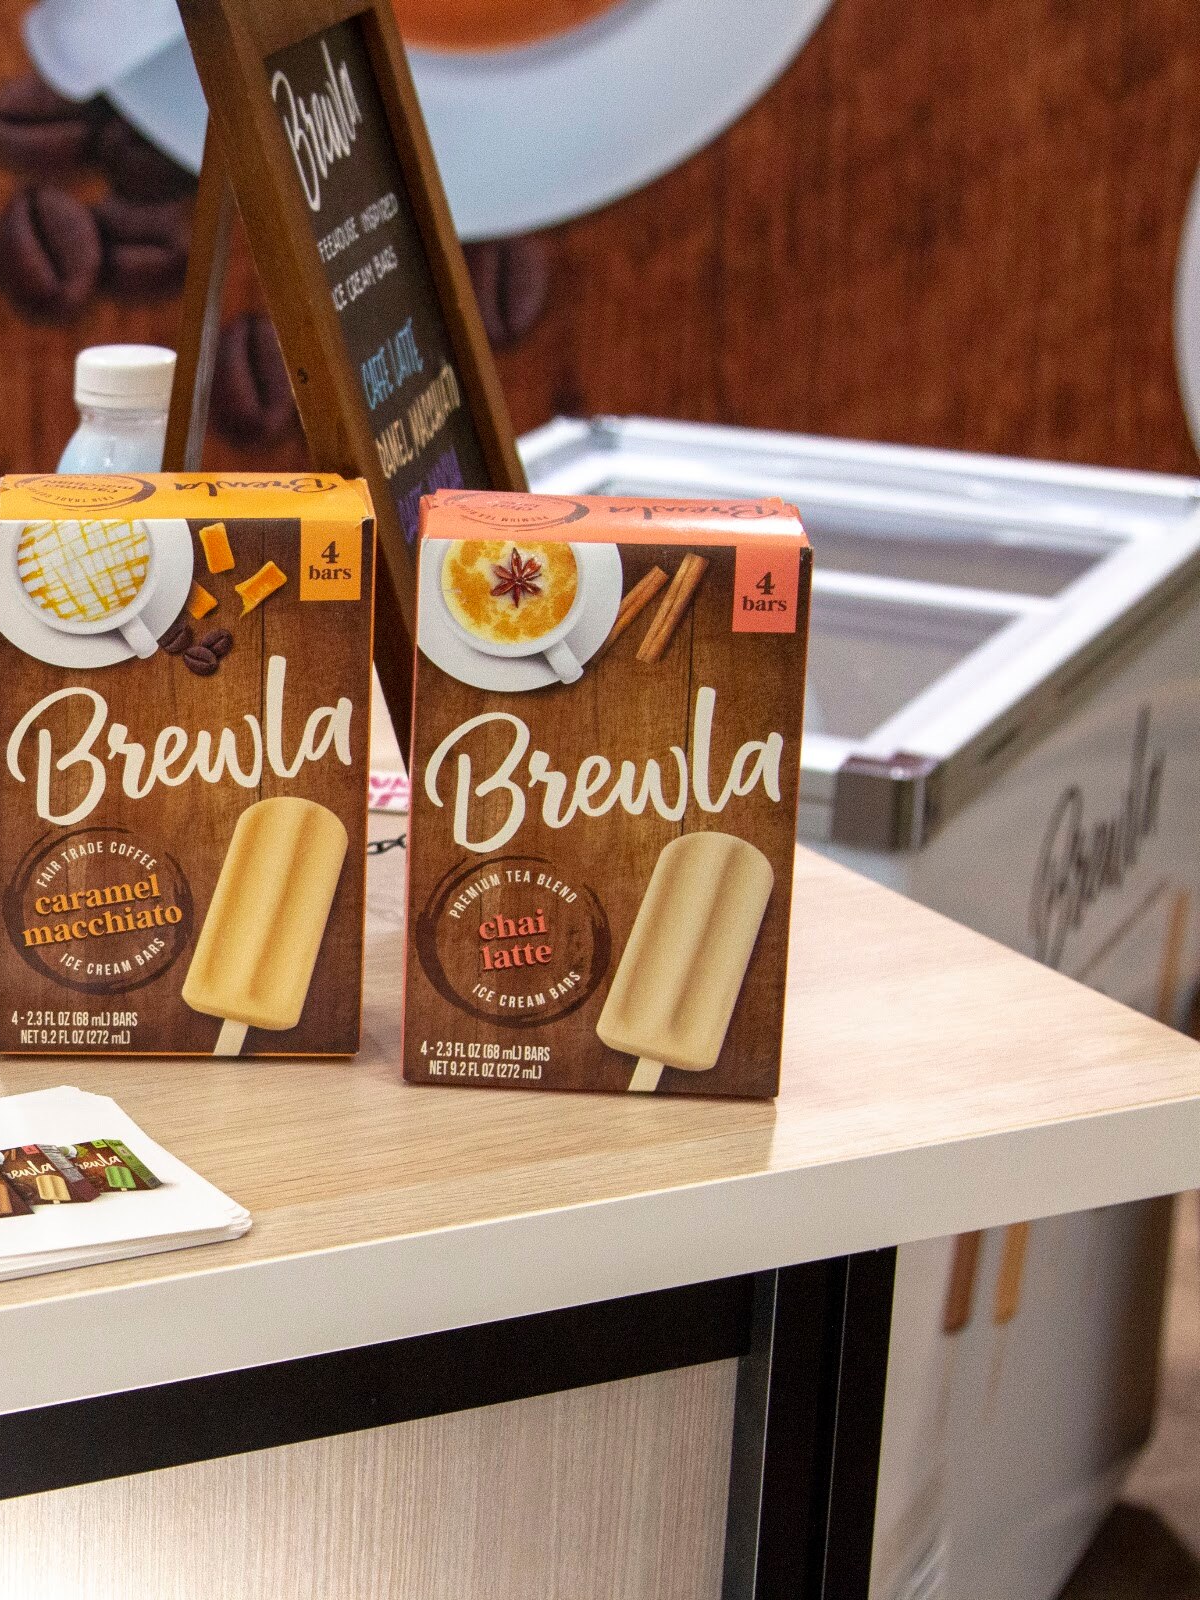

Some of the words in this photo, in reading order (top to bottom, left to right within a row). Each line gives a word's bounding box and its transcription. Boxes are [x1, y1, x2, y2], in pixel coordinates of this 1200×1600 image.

[271, 39, 363, 212] Brewla
[346, 262, 377, 302] CREAM
[372, 245, 398, 279] BARS
[174, 477, 338, 497] Brewla
[321, 541, 340, 564] 4
[308, 564, 352, 580] bars
[754, 571, 775, 595] 4
[741, 595, 787, 613] bars
[6, 654, 353, 826] Brewla
[424, 686, 783, 853] Brewla
[36, 861, 62, 888] FAIR
[61, 841, 104, 863] TRADE
[110, 841, 157, 870] COFFEE
[35, 873, 161, 916] caramel
[449, 873, 501, 919] PREMIUM
[506, 870, 531, 883] TEA
[536, 873, 577, 904] BLEND
[22, 905, 183, 947] macchiato
[478, 908, 547, 941] chai
[60, 953, 82, 971] ICE
[87, 961, 132, 975] CREAM
[135, 937, 165, 966] BARS
[481, 942, 552, 971] latte
[472, 984, 495, 1002] ICE
[499, 992, 546, 1008] CREAM
[549, 971, 581, 1000] BARS
[11, 1011, 18, 1025] 4
[27, 1011, 43, 1026] 2.3
[45, 1012, 55, 1026] FL
[58, 1012, 70, 1026] OZ
[72, 1012, 89, 1026] (68
[91, 1012, 110, 1027] mL)
[112, 1012, 138, 1027] BARS
[20, 1030, 38, 1044] NET
[40, 1030, 57, 1044] 9.2
[59, 1030, 70, 1044] FL
[72, 1030, 84, 1044] OZ
[86, 1030, 109, 1044] (272
[111, 1030, 130, 1044] mL)
[420, 1041, 427, 1056] 4
[437, 1041, 452, 1057] 2.3
[455, 1042, 466, 1058] FL
[468, 1043, 481, 1059] OZ
[483, 1043, 500, 1060] (68
[502, 1044, 522, 1061] mL)
[524, 1046, 550, 1062] BARS
[429, 1060, 447, 1076] NET
[450, 1061, 466, 1076] 9.2
[468, 1062, 479, 1077] FL
[482, 1062, 494, 1078] OZ
[496, 1063, 520, 1079] (272
[522, 1064, 542, 1080] mL)
[75, 1153, 122, 1171] rewla
